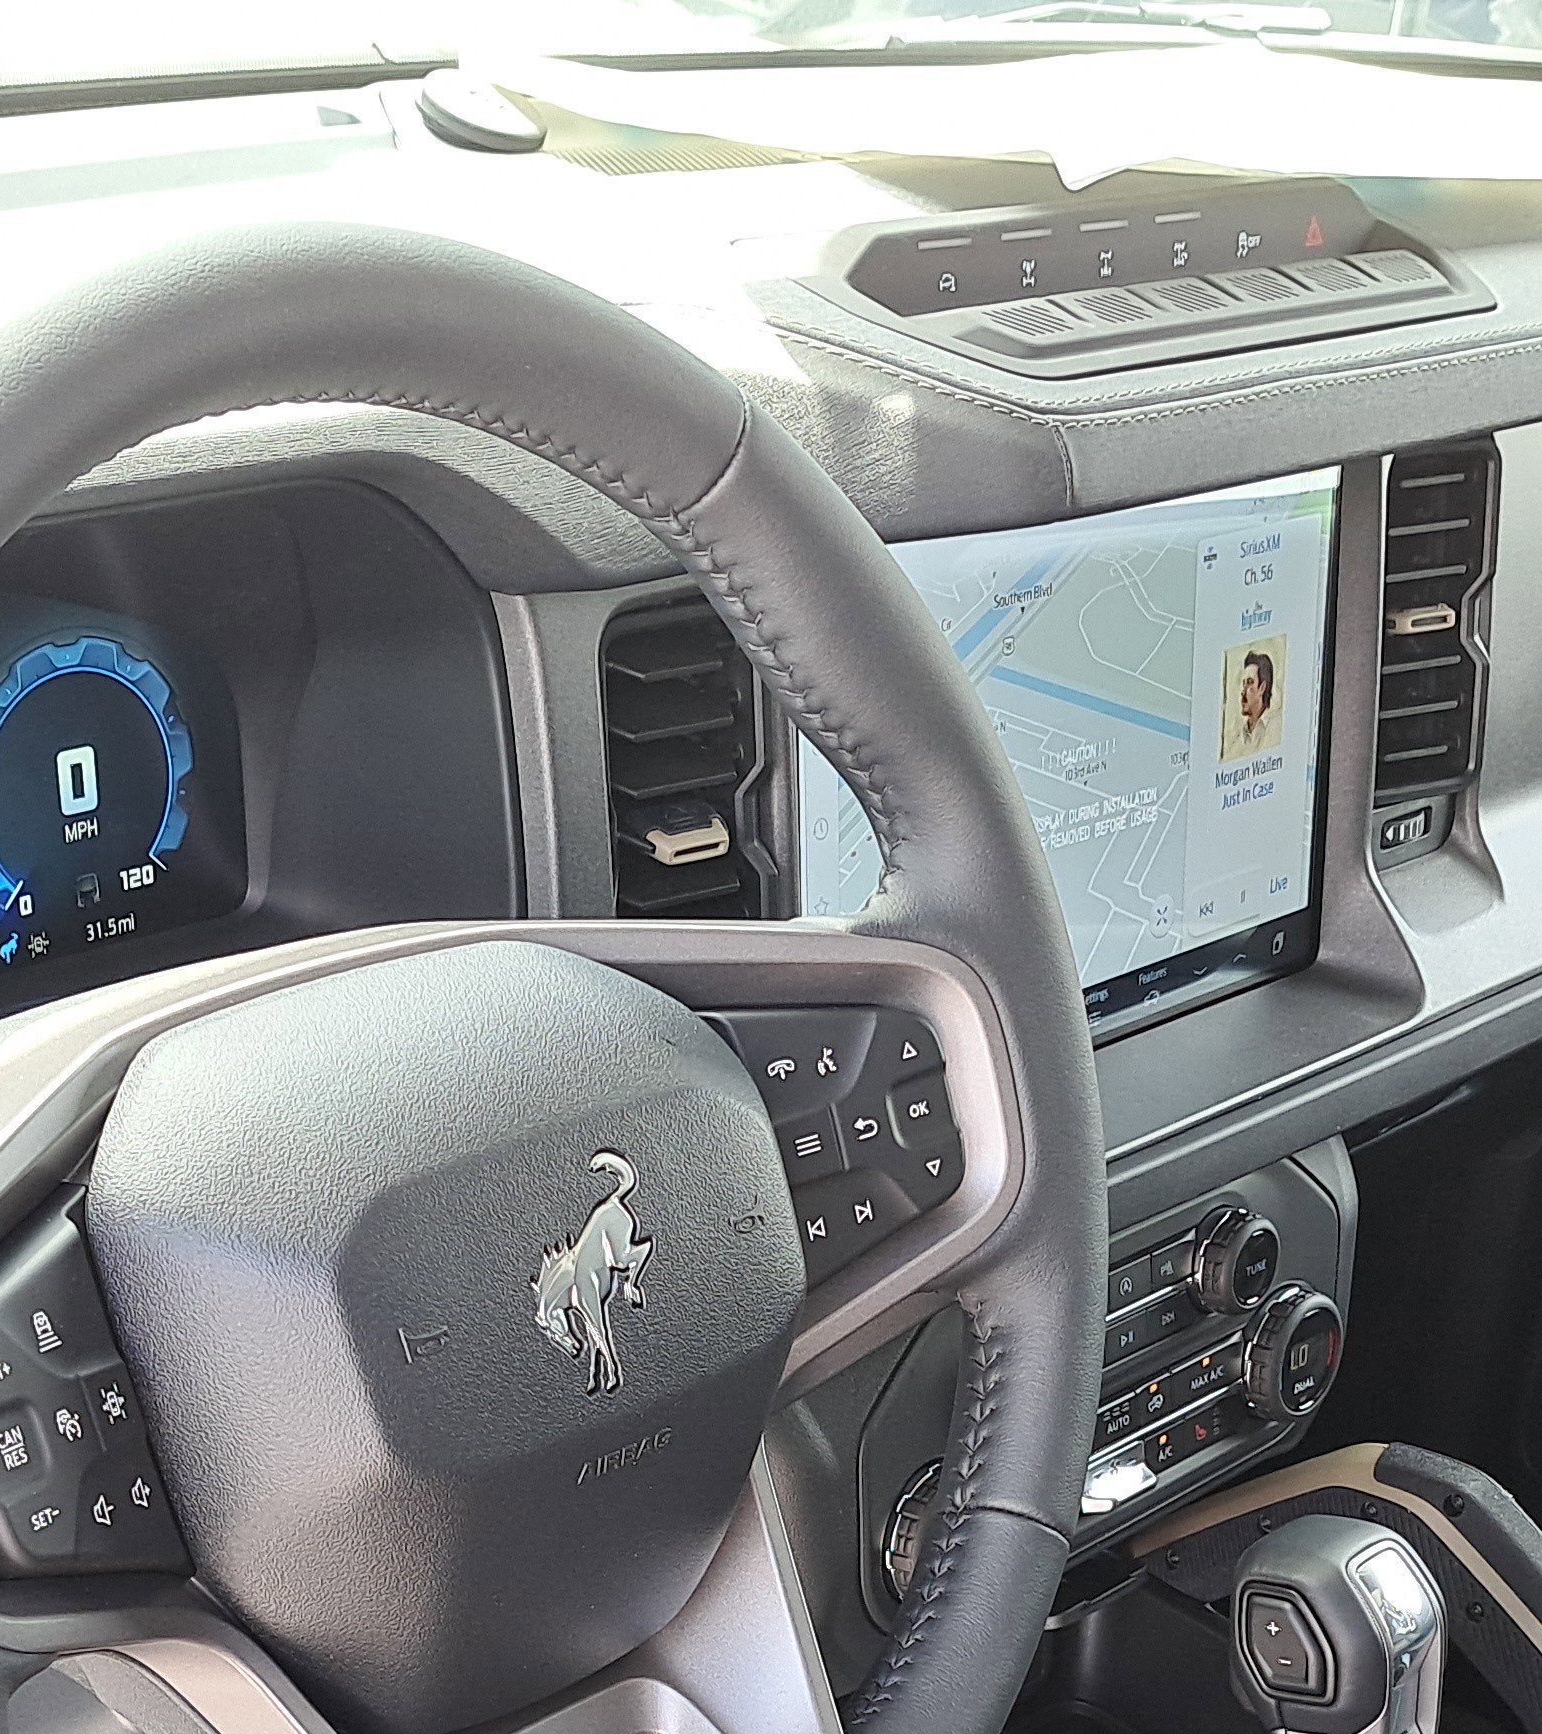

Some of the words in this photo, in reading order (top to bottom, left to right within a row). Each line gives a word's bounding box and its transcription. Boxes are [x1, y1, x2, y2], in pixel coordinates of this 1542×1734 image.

[1239, 533, 1281, 559] SiriusXM
[1260, 563, 1274, 583] 56
[993, 588, 1033, 609] Southern
[1034, 582, 1053, 600] Blvd
[56, 744, 99, 817] 0
[1215, 766, 1251, 788] Morgan
[1252, 756, 1283, 777] Wallen
[1068, 802, 1100, 825] DURING
[1102, 787, 1158, 816] INSTALLATION
[1222, 791, 1241, 811] Just
[1242, 787, 1252, 802] In
[1252, 781, 1274, 800] Case
[64, 817, 99, 844] MPH
[120, 864, 155, 891] 120
[1269, 876, 1288, 894] Live
[18, 894, 33, 916] 0
[1138, 967, 1168, 986] Features
[909, 1100, 930, 1118] OK
[1190, 1376, 1209, 1390] MAX
[1210, 1365, 1226, 1381] A/C
[1293, 1376, 1315, 1395] DUAL
[1107, 1414, 1130, 1434] AUTO
[3, 1450, 28, 1471] RES
[577, 1427, 673, 1486] AIRBAG
[1158, 1445, 1174, 1462] A/C
